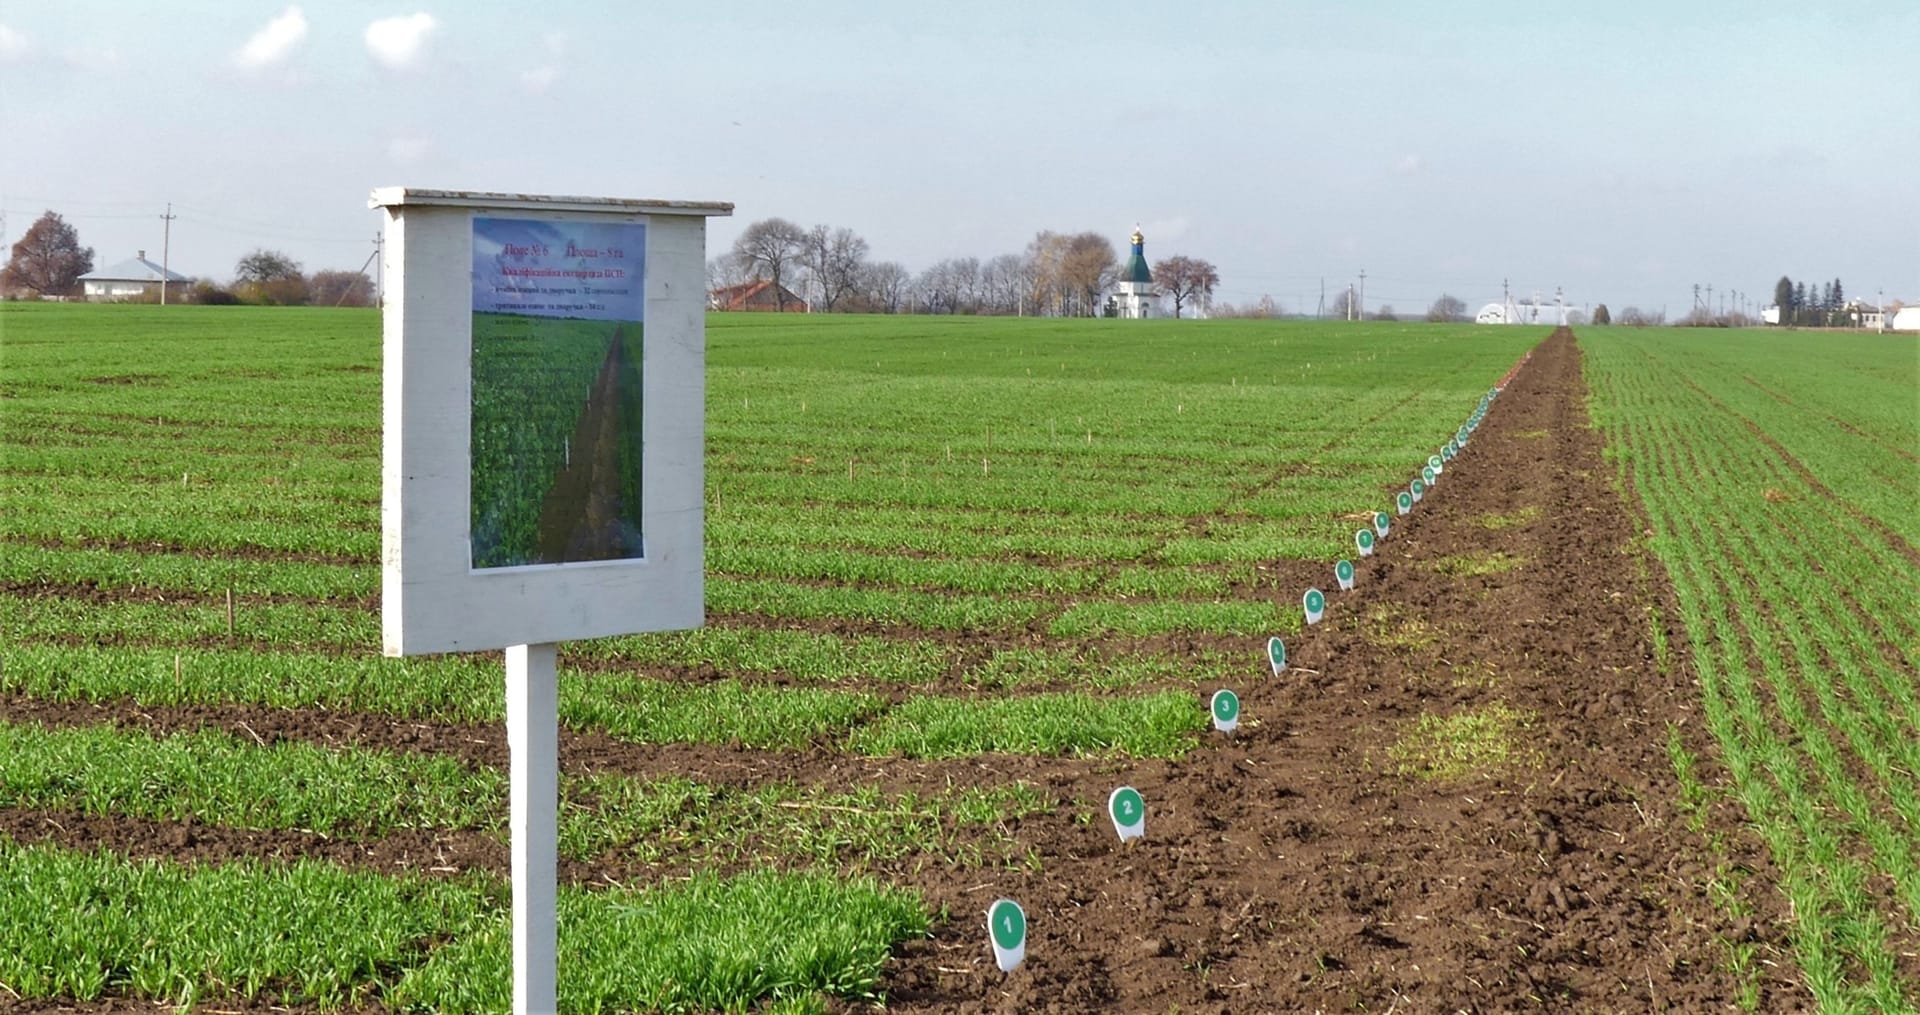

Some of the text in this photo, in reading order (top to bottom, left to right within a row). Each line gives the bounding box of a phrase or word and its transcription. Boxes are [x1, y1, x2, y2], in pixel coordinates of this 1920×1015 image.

[505, 243, 529, 256] Поле
[531, 244, 542, 256] №
[543, 246, 550, 257] 6
[1311, 597, 1317, 606] 5
[1221, 700, 1230, 712] 3
[1122, 800, 1133, 815] 2
[1003, 916, 1012, 933] 1
